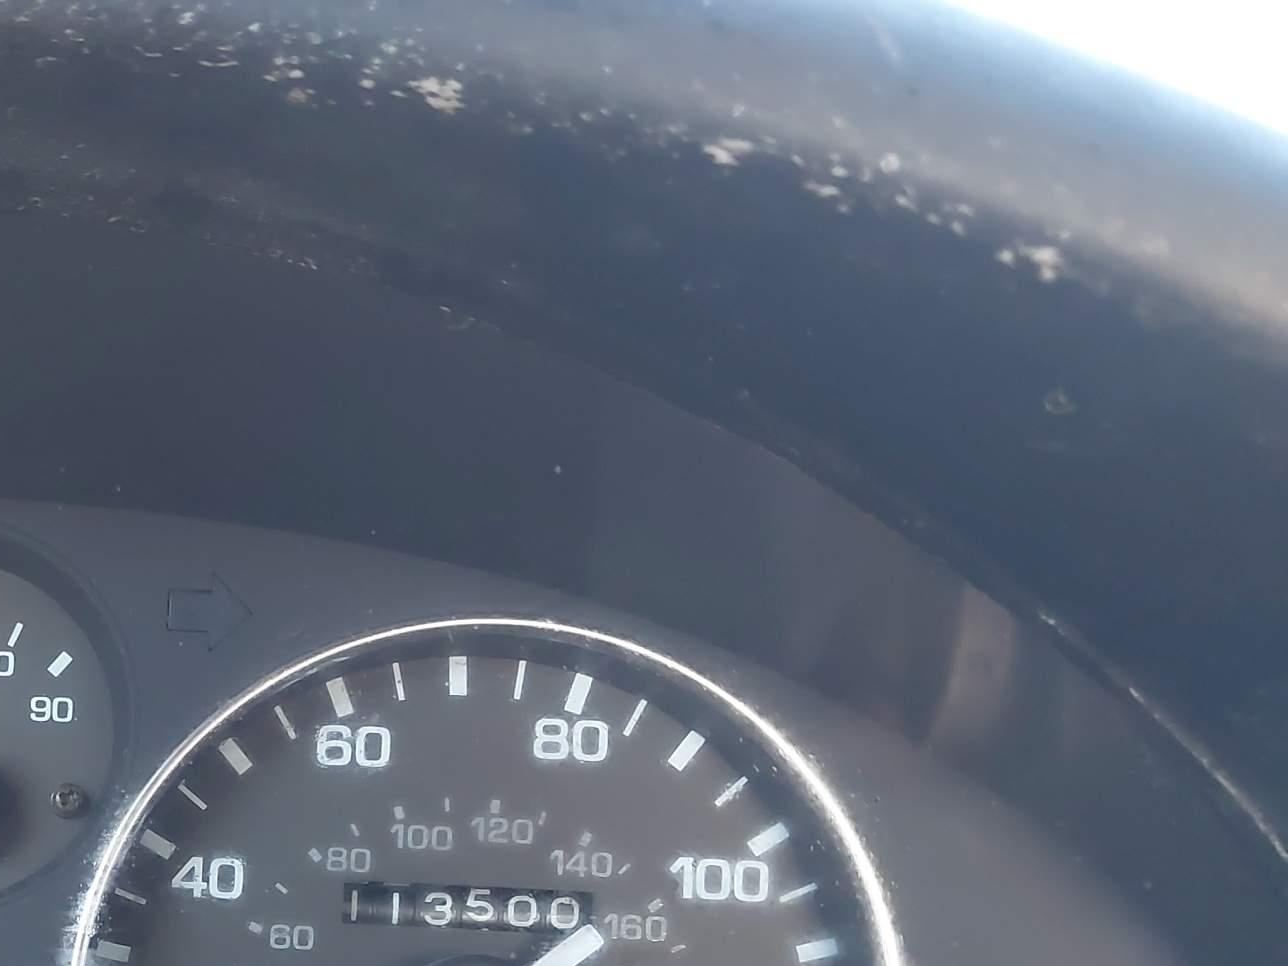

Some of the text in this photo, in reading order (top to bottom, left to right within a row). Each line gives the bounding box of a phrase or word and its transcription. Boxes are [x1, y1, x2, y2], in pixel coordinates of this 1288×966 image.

[30, 697, 73, 722] 90
[315, 724, 391, 767] 60
[533, 718, 608, 761] 80
[391, 824, 453, 850] 100
[471, 817, 533, 844] 120
[326, 847, 371, 872] 80
[550, 850, 612, 877] 140
[172, 856, 244, 899] 40
[669, 857, 769, 902] 100
[351, 888, 580, 929] 113500
[269, 924, 314, 950] 60
[604, 913, 667, 941] 160
